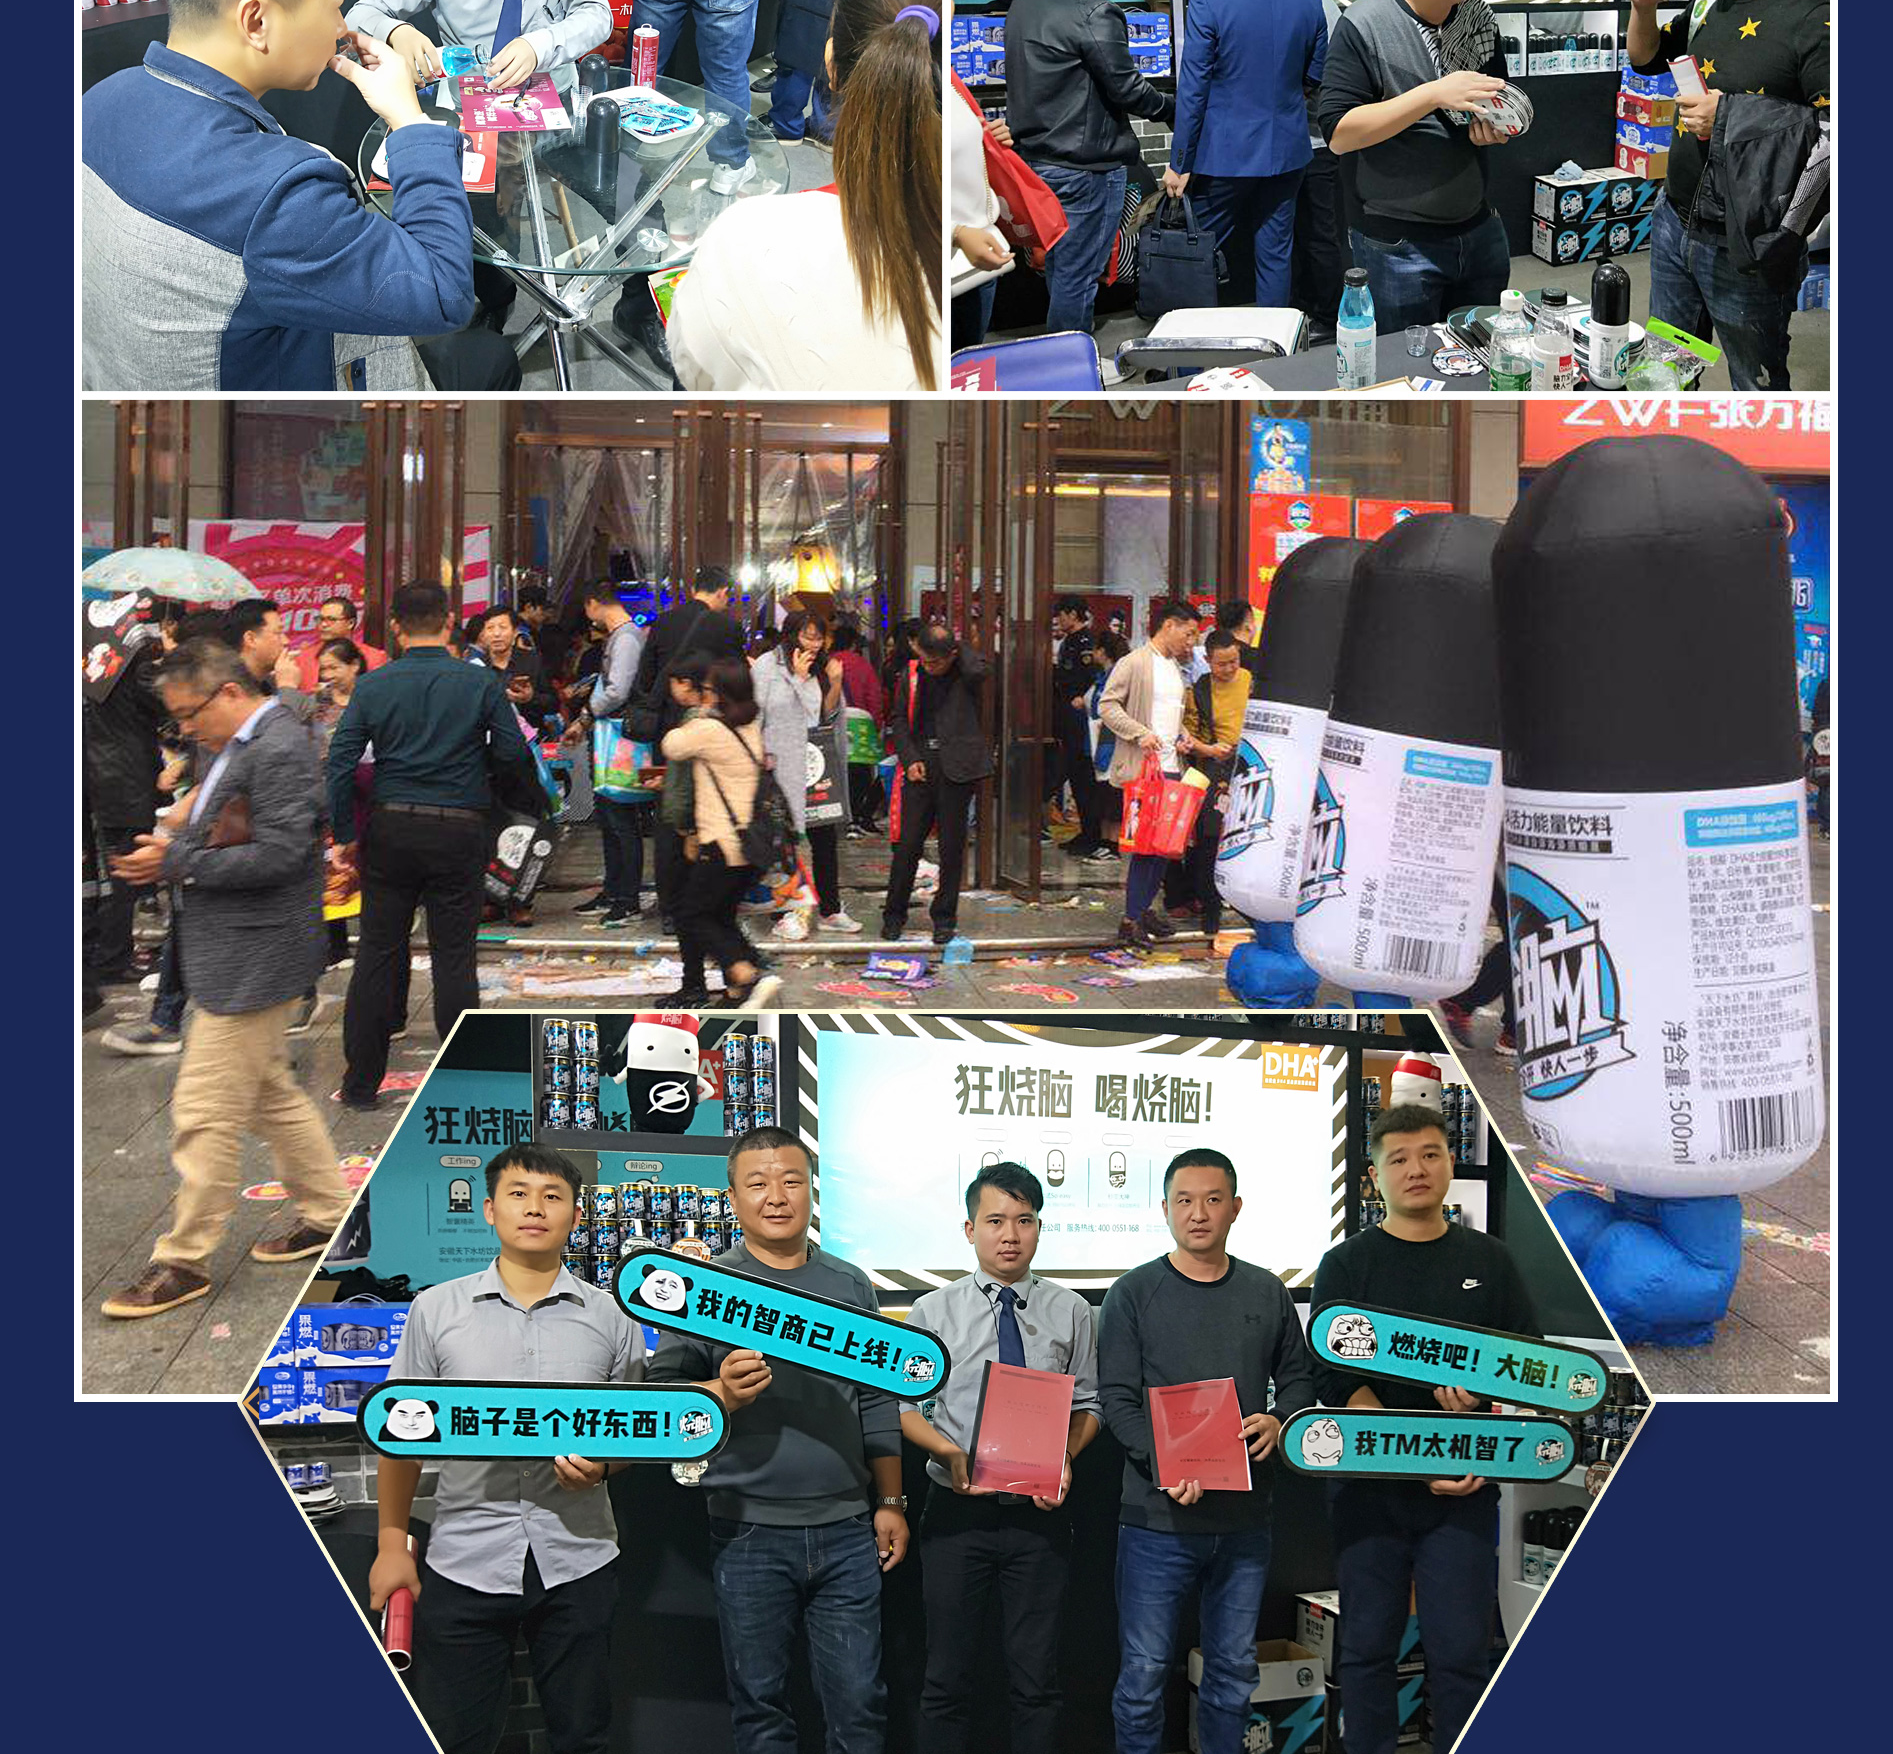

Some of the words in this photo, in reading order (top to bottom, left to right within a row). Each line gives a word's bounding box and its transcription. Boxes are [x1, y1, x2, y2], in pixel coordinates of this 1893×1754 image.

[954, 1063, 1073, 1119] 狂烧脑
[1095, 1073, 1212, 1124] 喝烧脑!
[1660, 1019, 1697, 1165] 净含量:500ml
[424, 1105, 533, 1147] 狂烧脑
[696, 1288, 902, 1372] 我的智商已上线!
[450, 1404, 671, 1438] 脑子是个好东西!
[1354, 1429, 1525, 1463] 我TM太机智了
